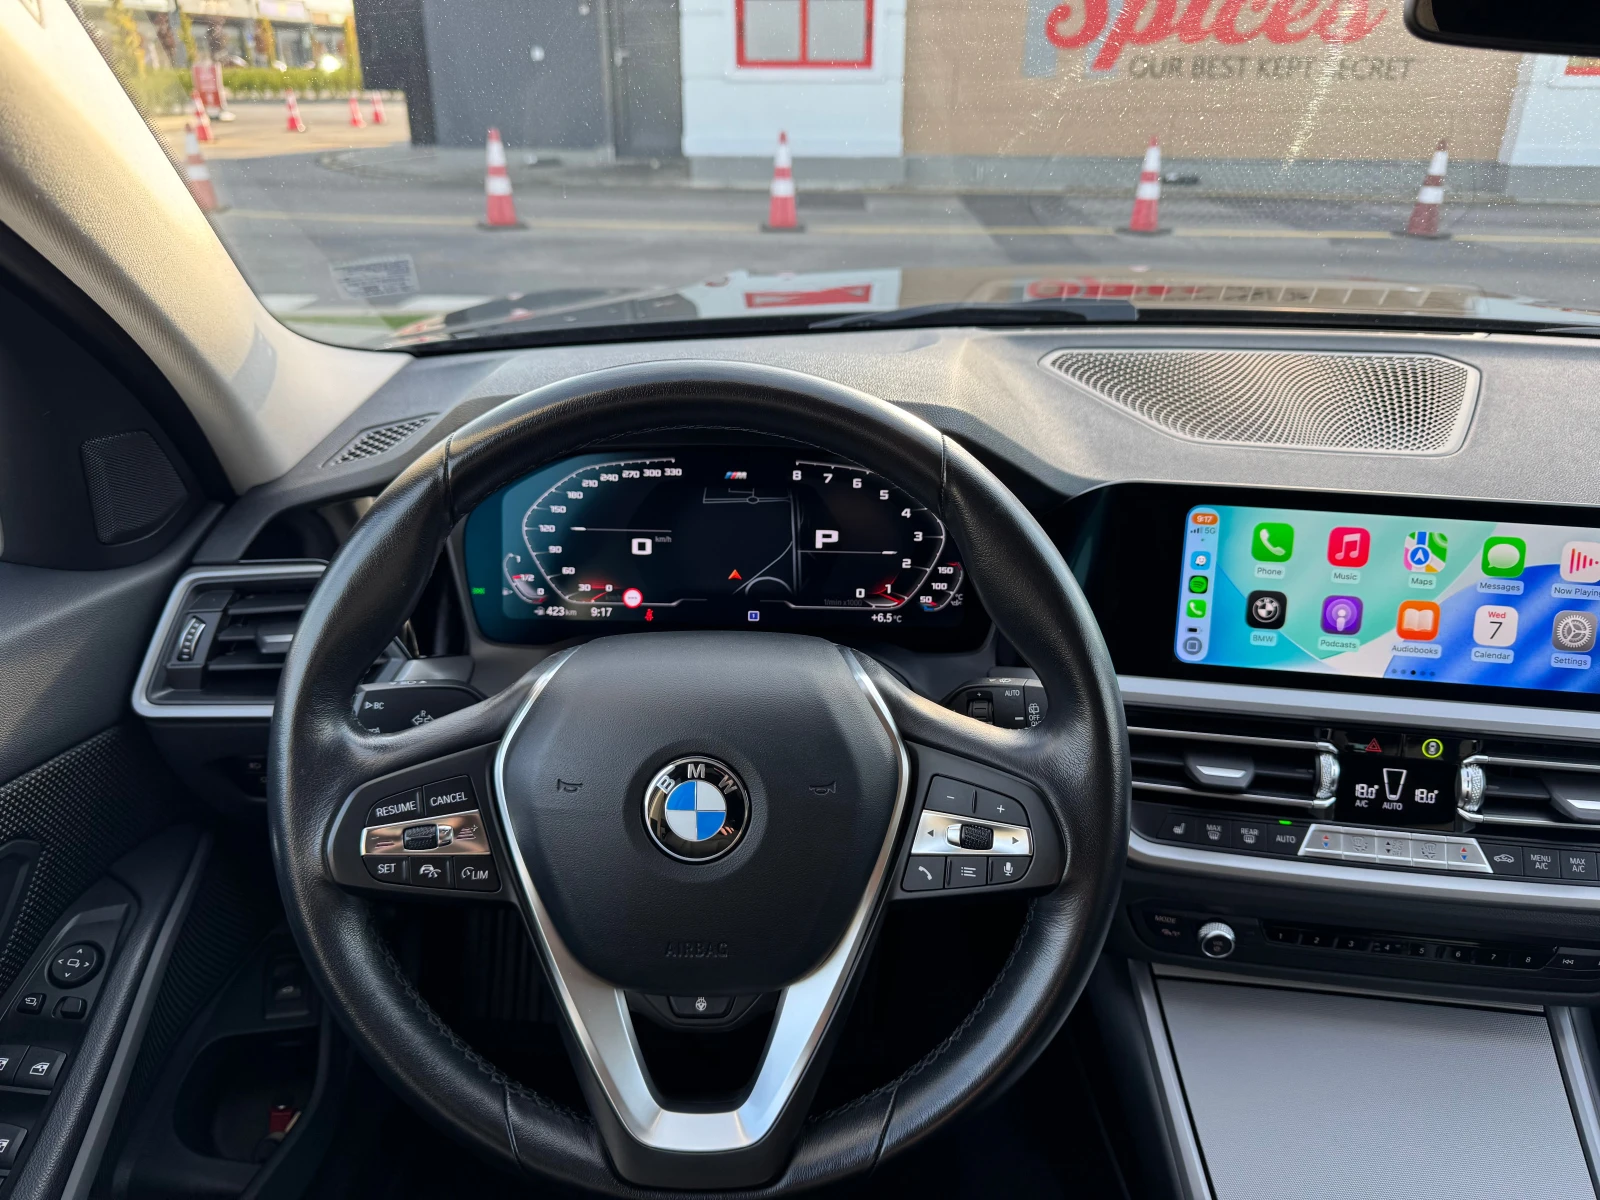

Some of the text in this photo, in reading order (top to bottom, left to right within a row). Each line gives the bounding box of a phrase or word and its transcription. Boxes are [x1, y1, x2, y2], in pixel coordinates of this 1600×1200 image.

[1129, 55, 1414, 80] OUR BEST KEPT ECRET
[622, 470, 640, 479] 270
[643, 468, 661, 478] 300
[664, 467, 682, 477] 330
[792, 470, 802, 481] 8
[600, 473, 619, 483] 240
[823, 473, 833, 484] 7
[581, 479, 599, 489] 210
[852, 478, 862, 489] 6
[879, 489, 889, 500] 5
[550, 505, 567, 514] 150
[901, 507, 911, 519] 4
[1196, 514, 1213, 524] 9:17
[539, 524, 556, 533] 120
[1204, 527, 1216, 535] 5G
[655, 534, 672, 543] km/h
[815, 529, 839, 549] P
[913, 531, 923, 542] 3
[631, 537, 653, 556] 0
[902, 558, 911, 569] 2
[562, 566, 575, 575] 60
[937, 566, 954, 575] 150
[1256, 567, 1282, 576] Phone
[1333, 572, 1358, 581] Music
[931, 582, 948, 590] 100
[1411, 577, 1433, 587] Maps
[1479, 582, 1520, 592] Messages
[536, 587, 545, 596] 0
[578, 583, 591, 592] 30
[605, 583, 613, 592] 0
[885, 584, 892, 594] 1
[1553, 586, 1574, 596] Now
[856, 588, 865, 599] 0
[919, 595, 933, 603] 50
[545, 606, 565, 616] 423
[590, 607, 613, 617] 9:17
[1487, 611, 1507, 619] Wed
[871, 612, 893, 623] +6.5
[1489, 621, 1504, 640] 7
[1252, 634, 1274, 643] BMW
[1320, 639, 1357, 650] Podcasts
[1391, 645, 1439, 655] Audiobooks
[1474, 650, 1510, 660] Calendar
[1553, 656, 1588, 666] Settings
[1004, 689, 1020, 697] AUTO
[657, 763, 738, 795] BMW
[430, 791, 468, 807] CANCEL
[1355, 800, 1369, 808] A/C
[375, 800, 417, 818] RESUME
[1382, 802, 1403, 810] AUTO
[1206, 823, 1222, 832] MAX
[1240, 827, 1259, 836] REAR
[1275, 835, 1296, 844] AUTO
[1530, 854, 1552, 863] MENU
[1569, 857, 1585, 866] MAX
[377, 863, 397, 874] SET
[1535, 862, 1549, 870] A/C
[1572, 864, 1586, 873] A/C
[471, 870, 489, 880] LIM
[1154, 914, 1177, 924] MODE
[1278, 932, 1284, 940] 1
[1348, 940, 1355, 948] 3
[664, 941, 729, 959] AIRBAG
[1418, 947, 1425, 955] 5
[1491, 953, 1497, 961] 7
[1525, 956, 1532, 964] 8
